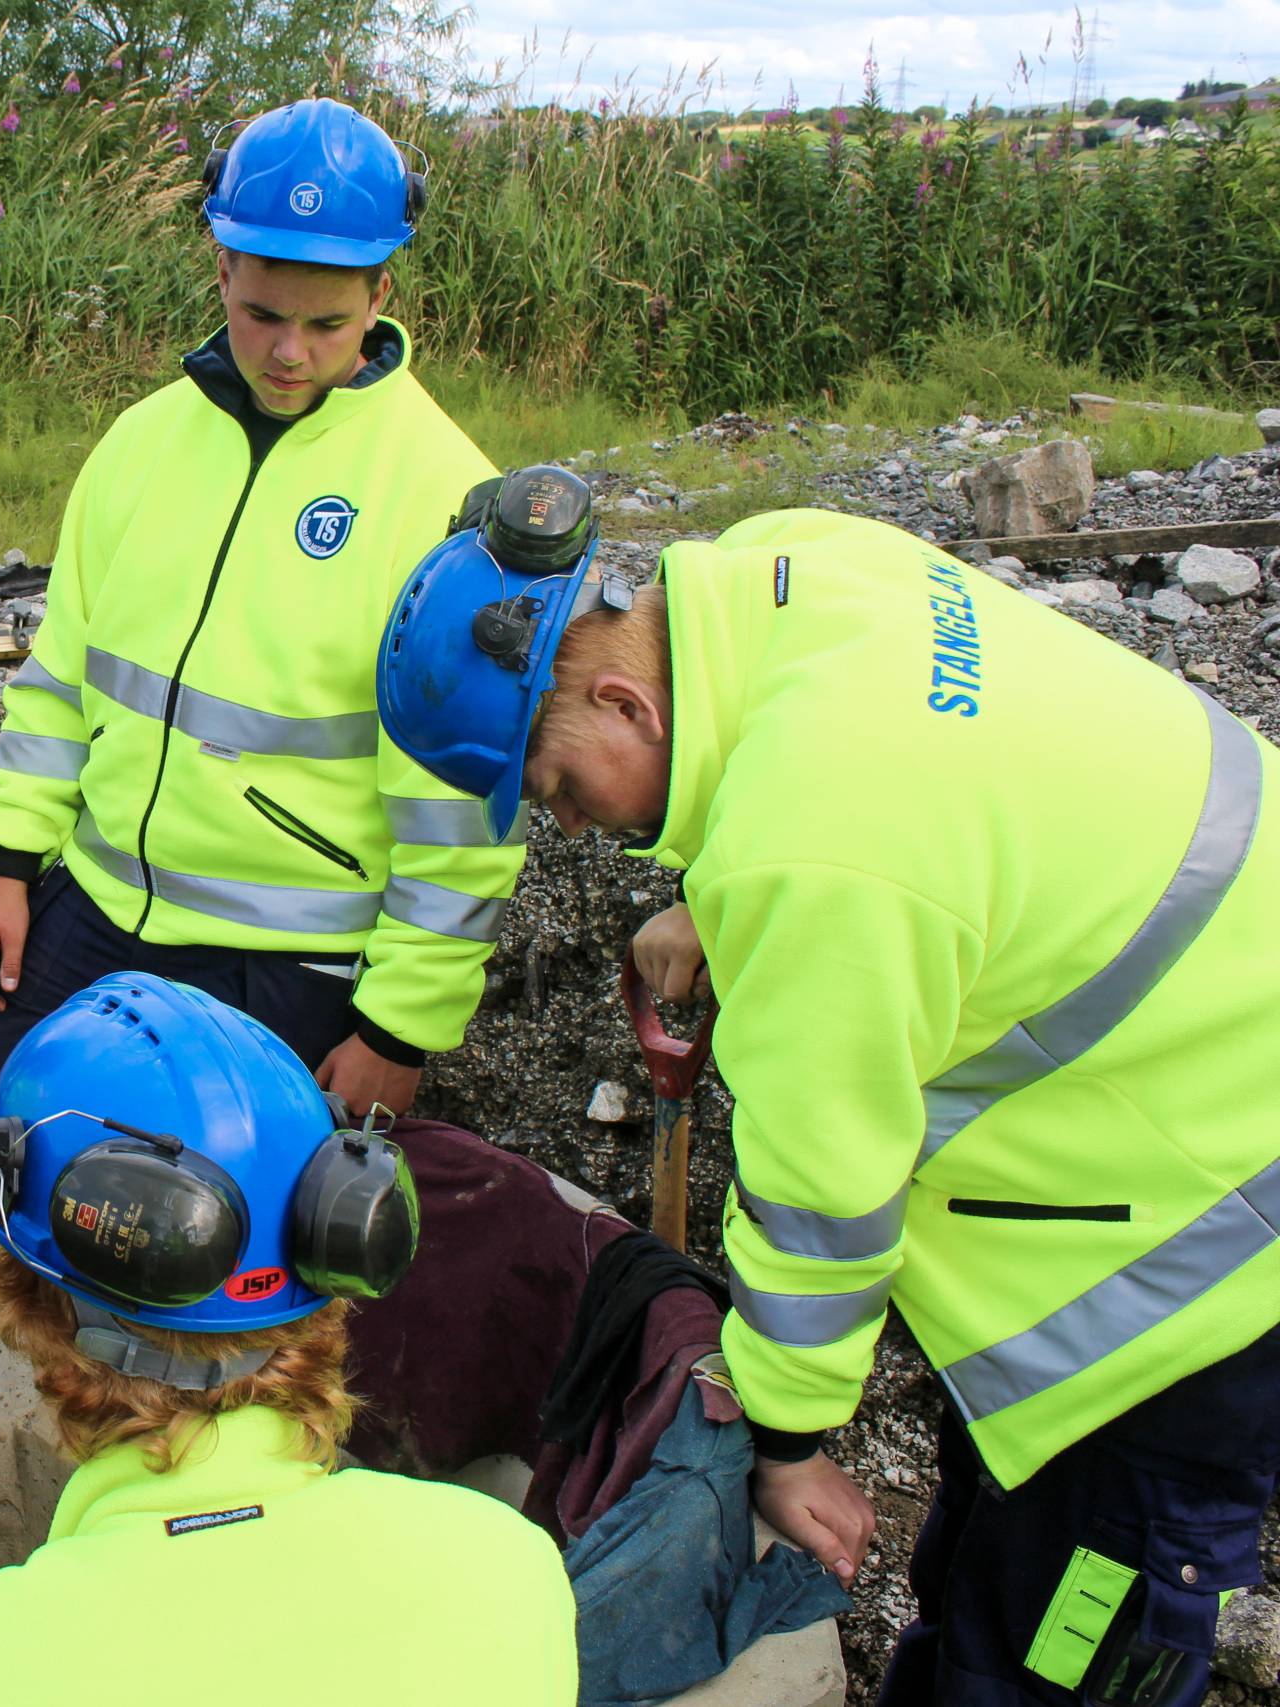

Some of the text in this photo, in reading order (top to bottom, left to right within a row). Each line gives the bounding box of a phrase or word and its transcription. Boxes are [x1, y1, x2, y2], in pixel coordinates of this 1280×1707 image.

[312, 511, 355, 543] TS
[528, 516, 545, 526] 3M
[62, 1196, 77, 1222] 3M
[94, 1200, 111, 1245] PELTOR
[236, 1271, 280, 1296] JSP
